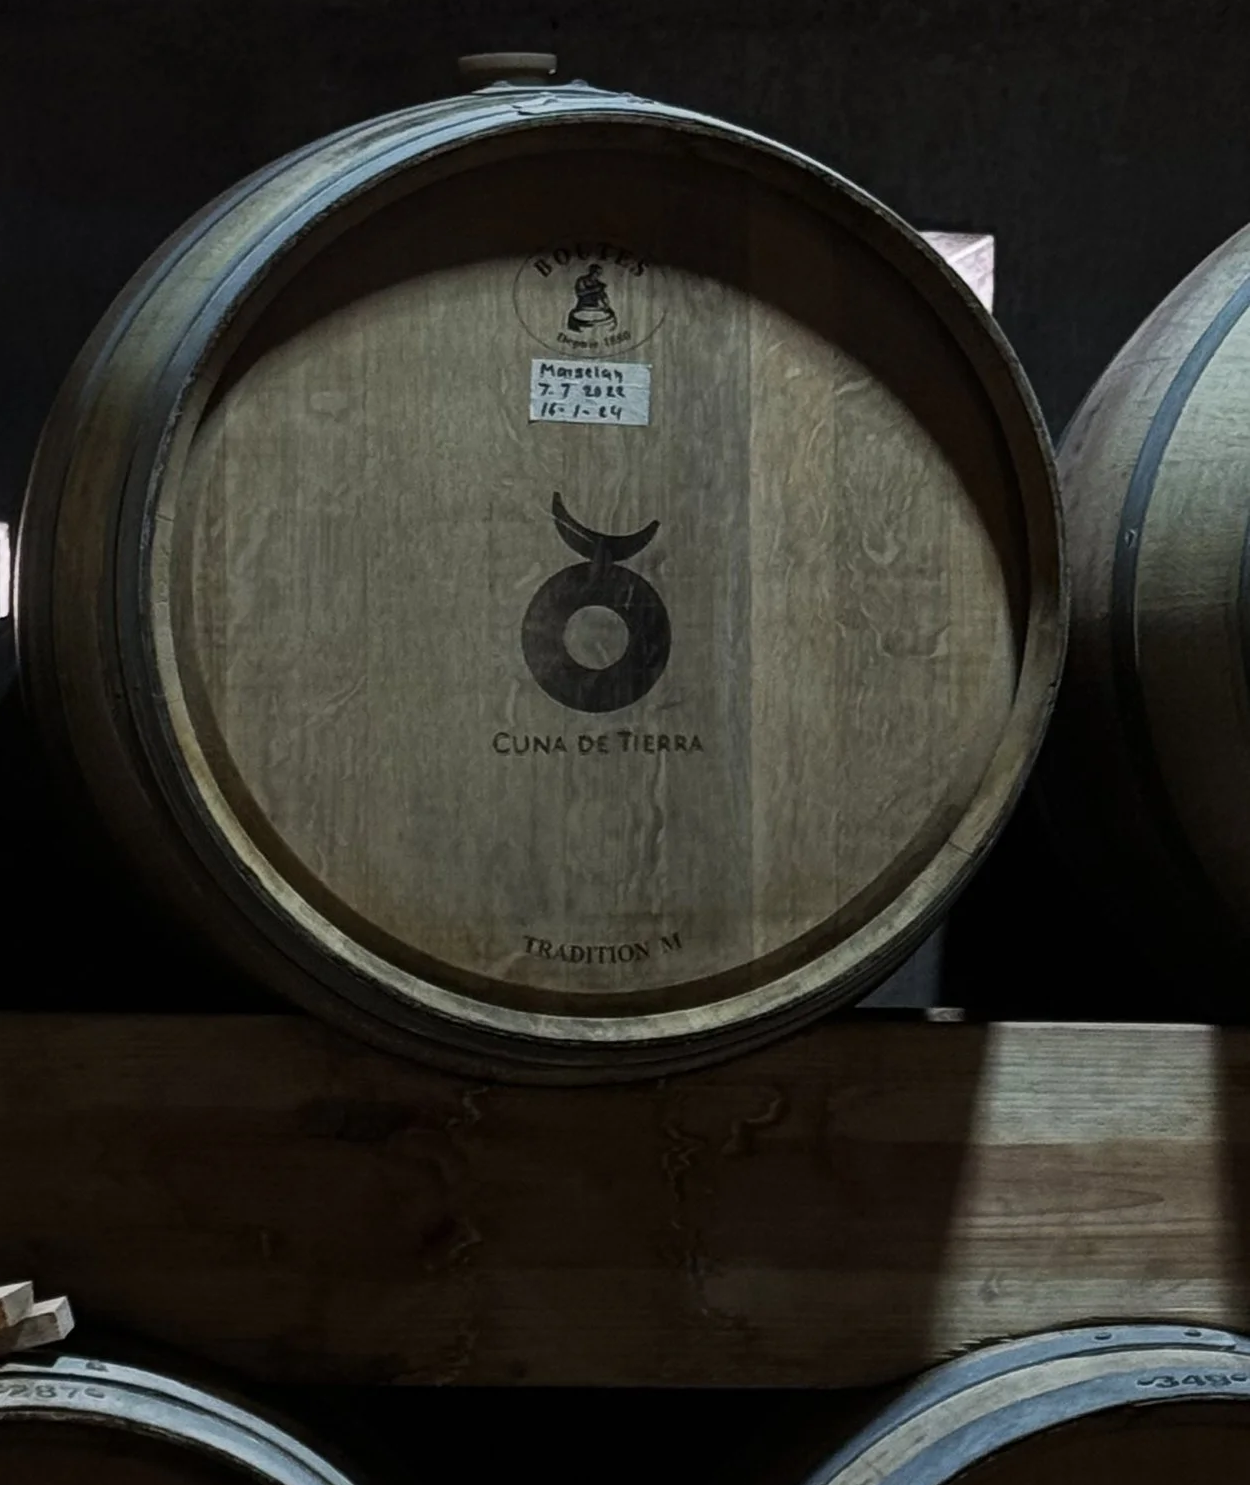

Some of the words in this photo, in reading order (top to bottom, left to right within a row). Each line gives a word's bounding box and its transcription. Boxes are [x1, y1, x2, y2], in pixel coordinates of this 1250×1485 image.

[534, 241, 646, 278] BOUTES
[492, 731, 568, 755] CUNA
[578, 734, 610, 755] DE
[616, 730, 704, 753] TIERRA
[522, 935, 651, 965] TRADITION
[660, 931, 683, 954] M
